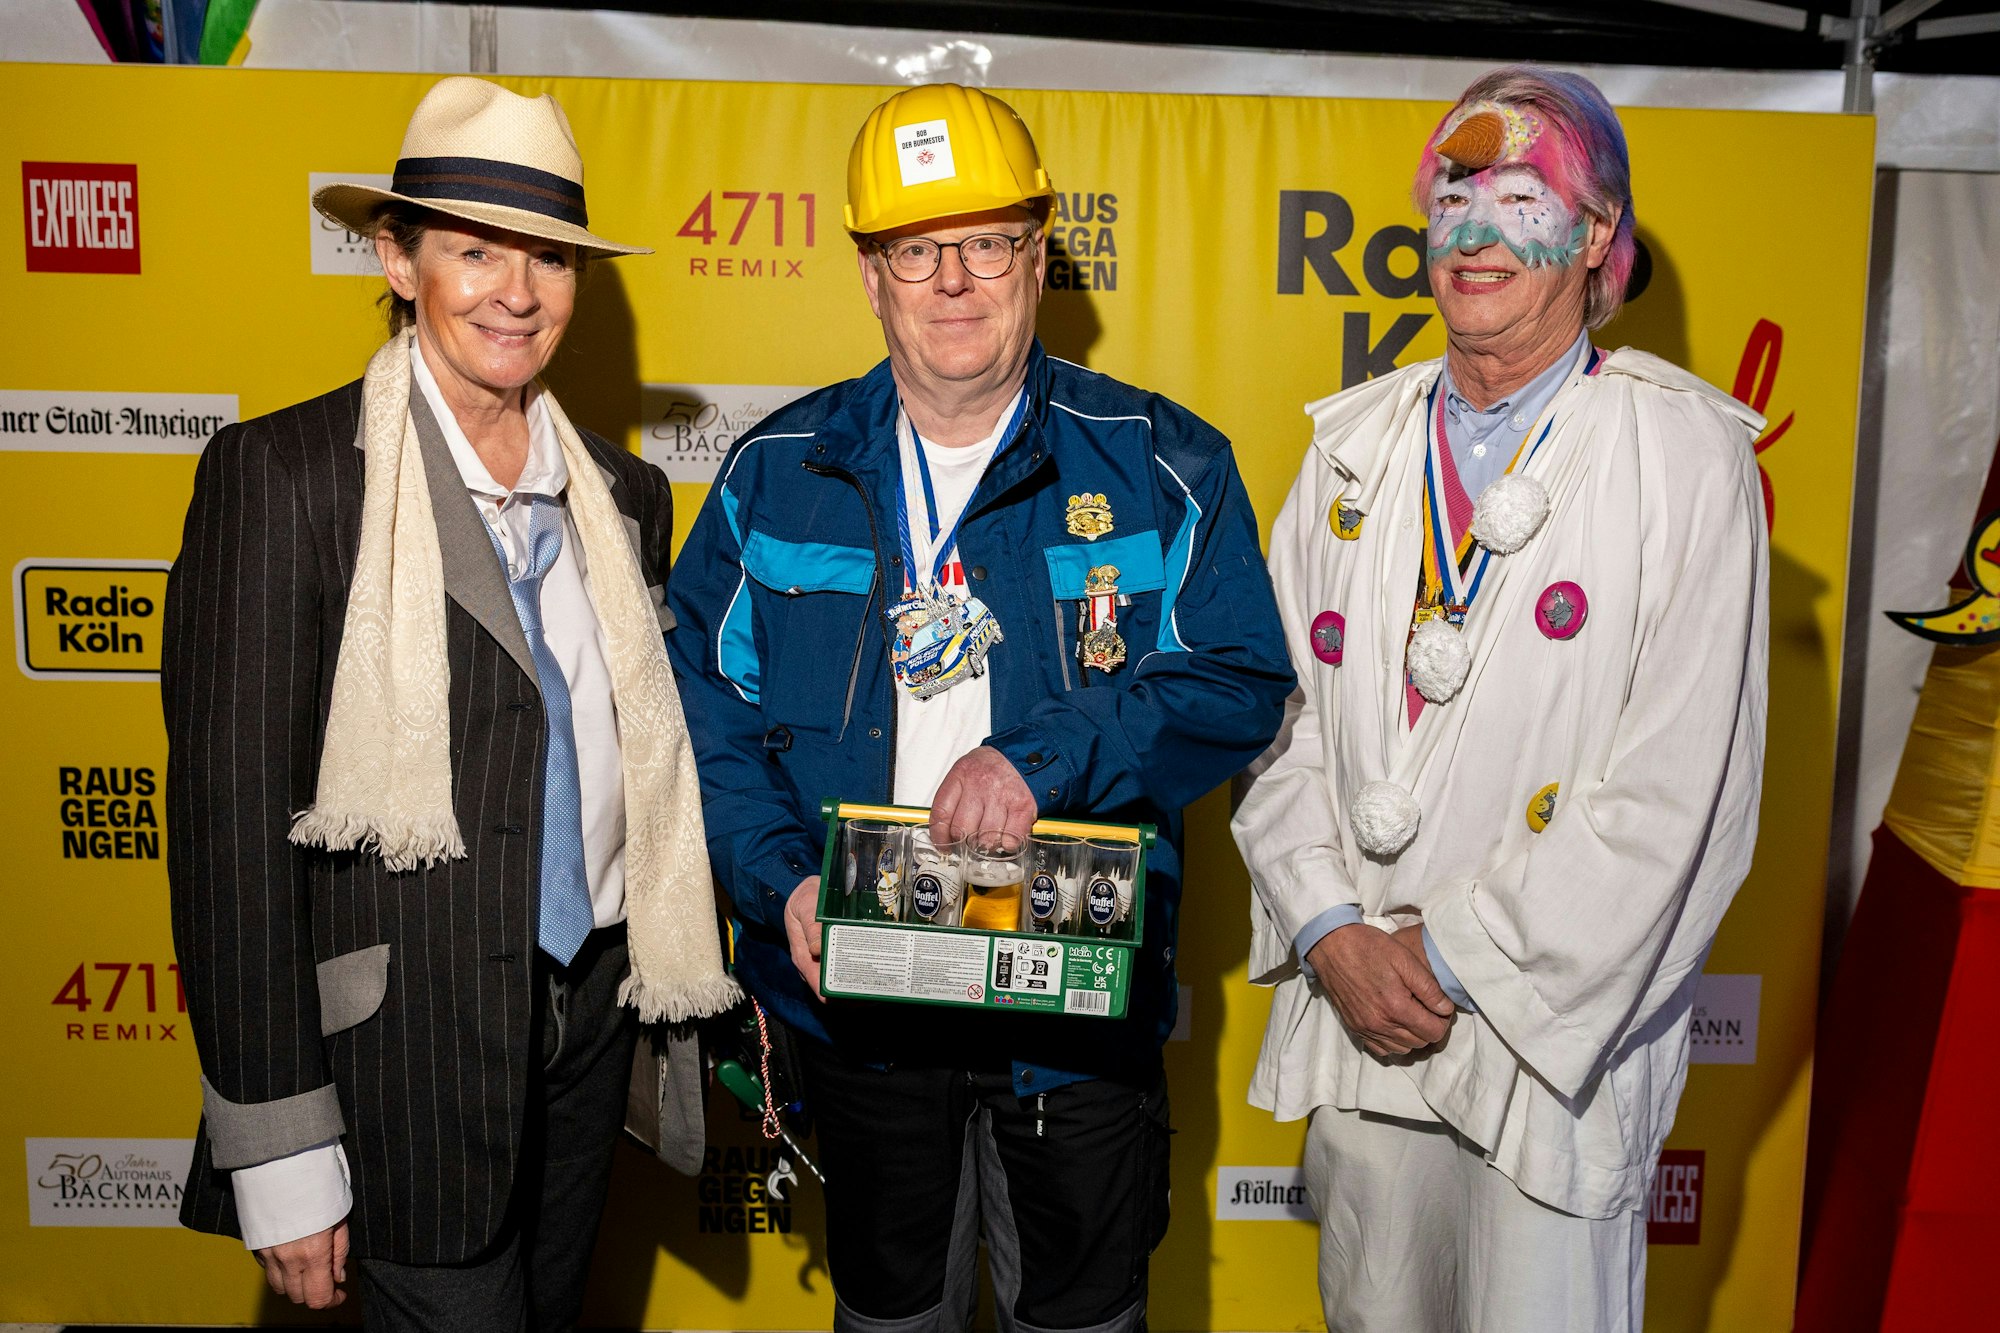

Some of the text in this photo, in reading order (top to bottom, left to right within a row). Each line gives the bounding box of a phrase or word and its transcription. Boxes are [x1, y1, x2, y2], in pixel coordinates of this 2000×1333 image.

[902, 135, 945, 150] DER BURMESTER
[916, 129, 927, 138] BOB
[29, 178, 134, 249] EXPRESS
[676, 190, 815, 247] 4711
[1056, 192, 1118, 224] AUS
[1048, 226, 1117, 257] EGA
[690, 258, 803, 278] REMIX
[1047, 259, 1117, 291] GEN
[0, 405, 40, 433] ner
[652, 402, 718, 440] 50
[45, 585, 154, 617] Radio
[58, 623, 143, 653] Köln
[59, 767, 156, 796] RAUS
[60, 799, 158, 828] GEGA
[62, 831, 160, 859] NGEN
[915, 890, 938, 902] Gaffel
[1031, 889, 1054, 901] Gaffel
[1090, 895, 1114, 908] Gaffel
[1068, 946, 1092, 958] klein
[51, 962, 188, 1012] 4711
[67, 1024, 177, 1040] REMIX
[38, 1154, 102, 1188] 50
[115, 1154, 158, 1169] Jahre
[60, 1174, 184, 1200] BÄCKMAN
[1230, 1180, 1306, 1205] Kölner
[1648, 1165, 1698, 1223] RESS
[699, 1207, 791, 1233] NGEN
